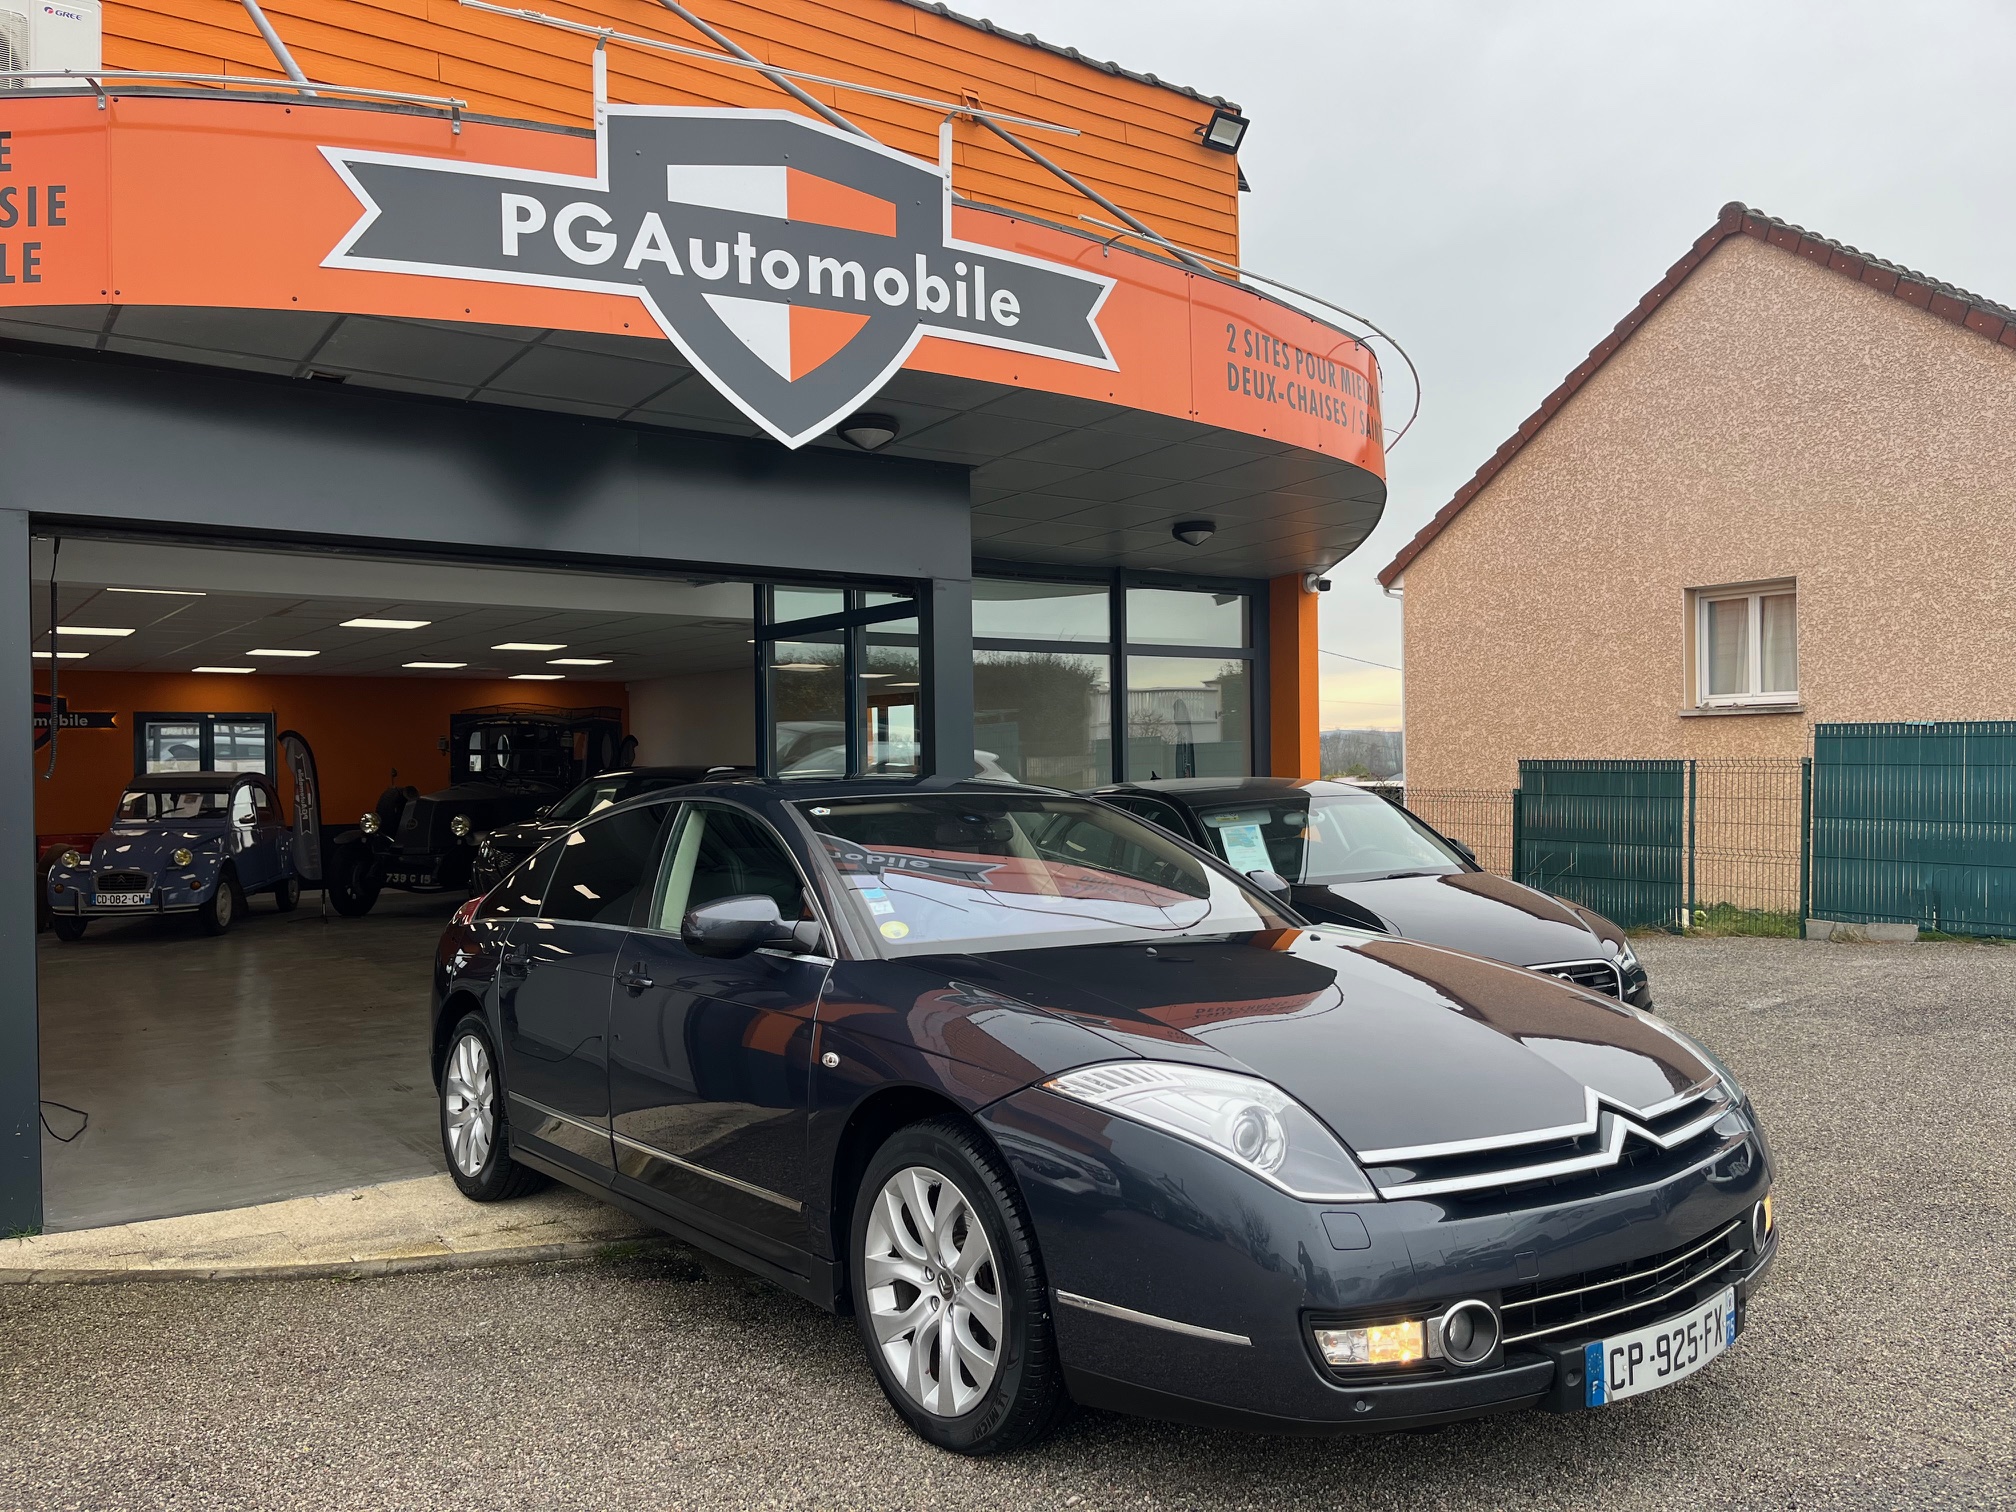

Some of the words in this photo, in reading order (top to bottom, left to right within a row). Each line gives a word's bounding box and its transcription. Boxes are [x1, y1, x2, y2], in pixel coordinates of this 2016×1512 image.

[55, 9, 83, 21] GREE
[500, 192, 1021, 328] PGAutomobile
[1226, 323, 1236, 354] 2
[1243, 328, 1290, 371] SITES
[1295, 347, 1337, 390] POUR
[1227, 361, 1348, 428] DEUX-CHAISES
[34, 714, 88, 726] mbile
[1609, 1303, 1723, 1391] CP-925-FX
[1726, 1317, 1735, 1340] 75
